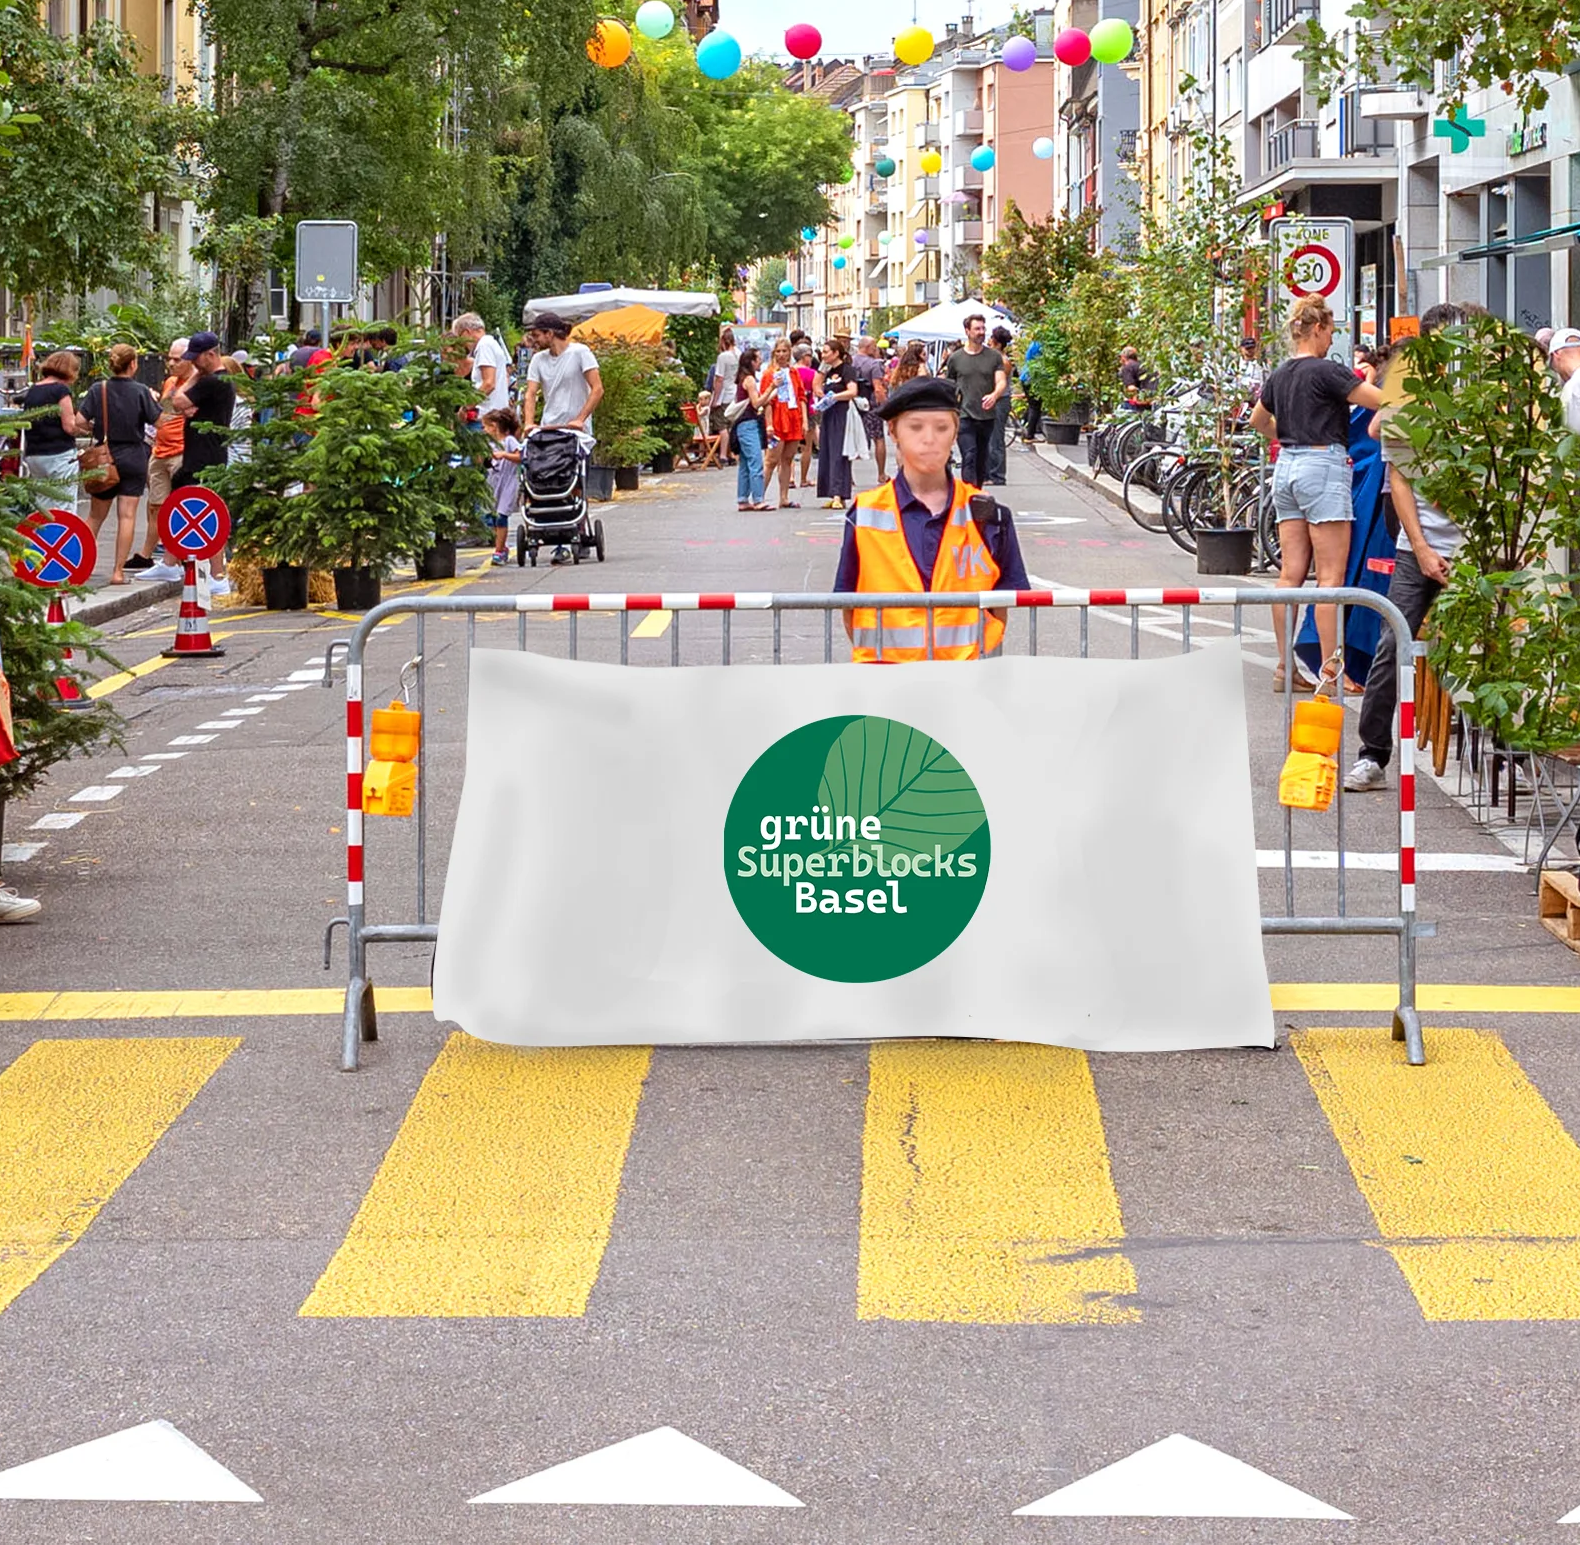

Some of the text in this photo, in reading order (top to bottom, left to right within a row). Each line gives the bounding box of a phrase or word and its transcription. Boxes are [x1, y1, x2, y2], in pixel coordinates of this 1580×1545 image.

[1299, 262, 1324, 283] 30
[952, 542, 991, 579] VK
[760, 805, 882, 850] grüne
[737, 844, 977, 886] Superblocks
[795, 880, 908, 914] Basel
